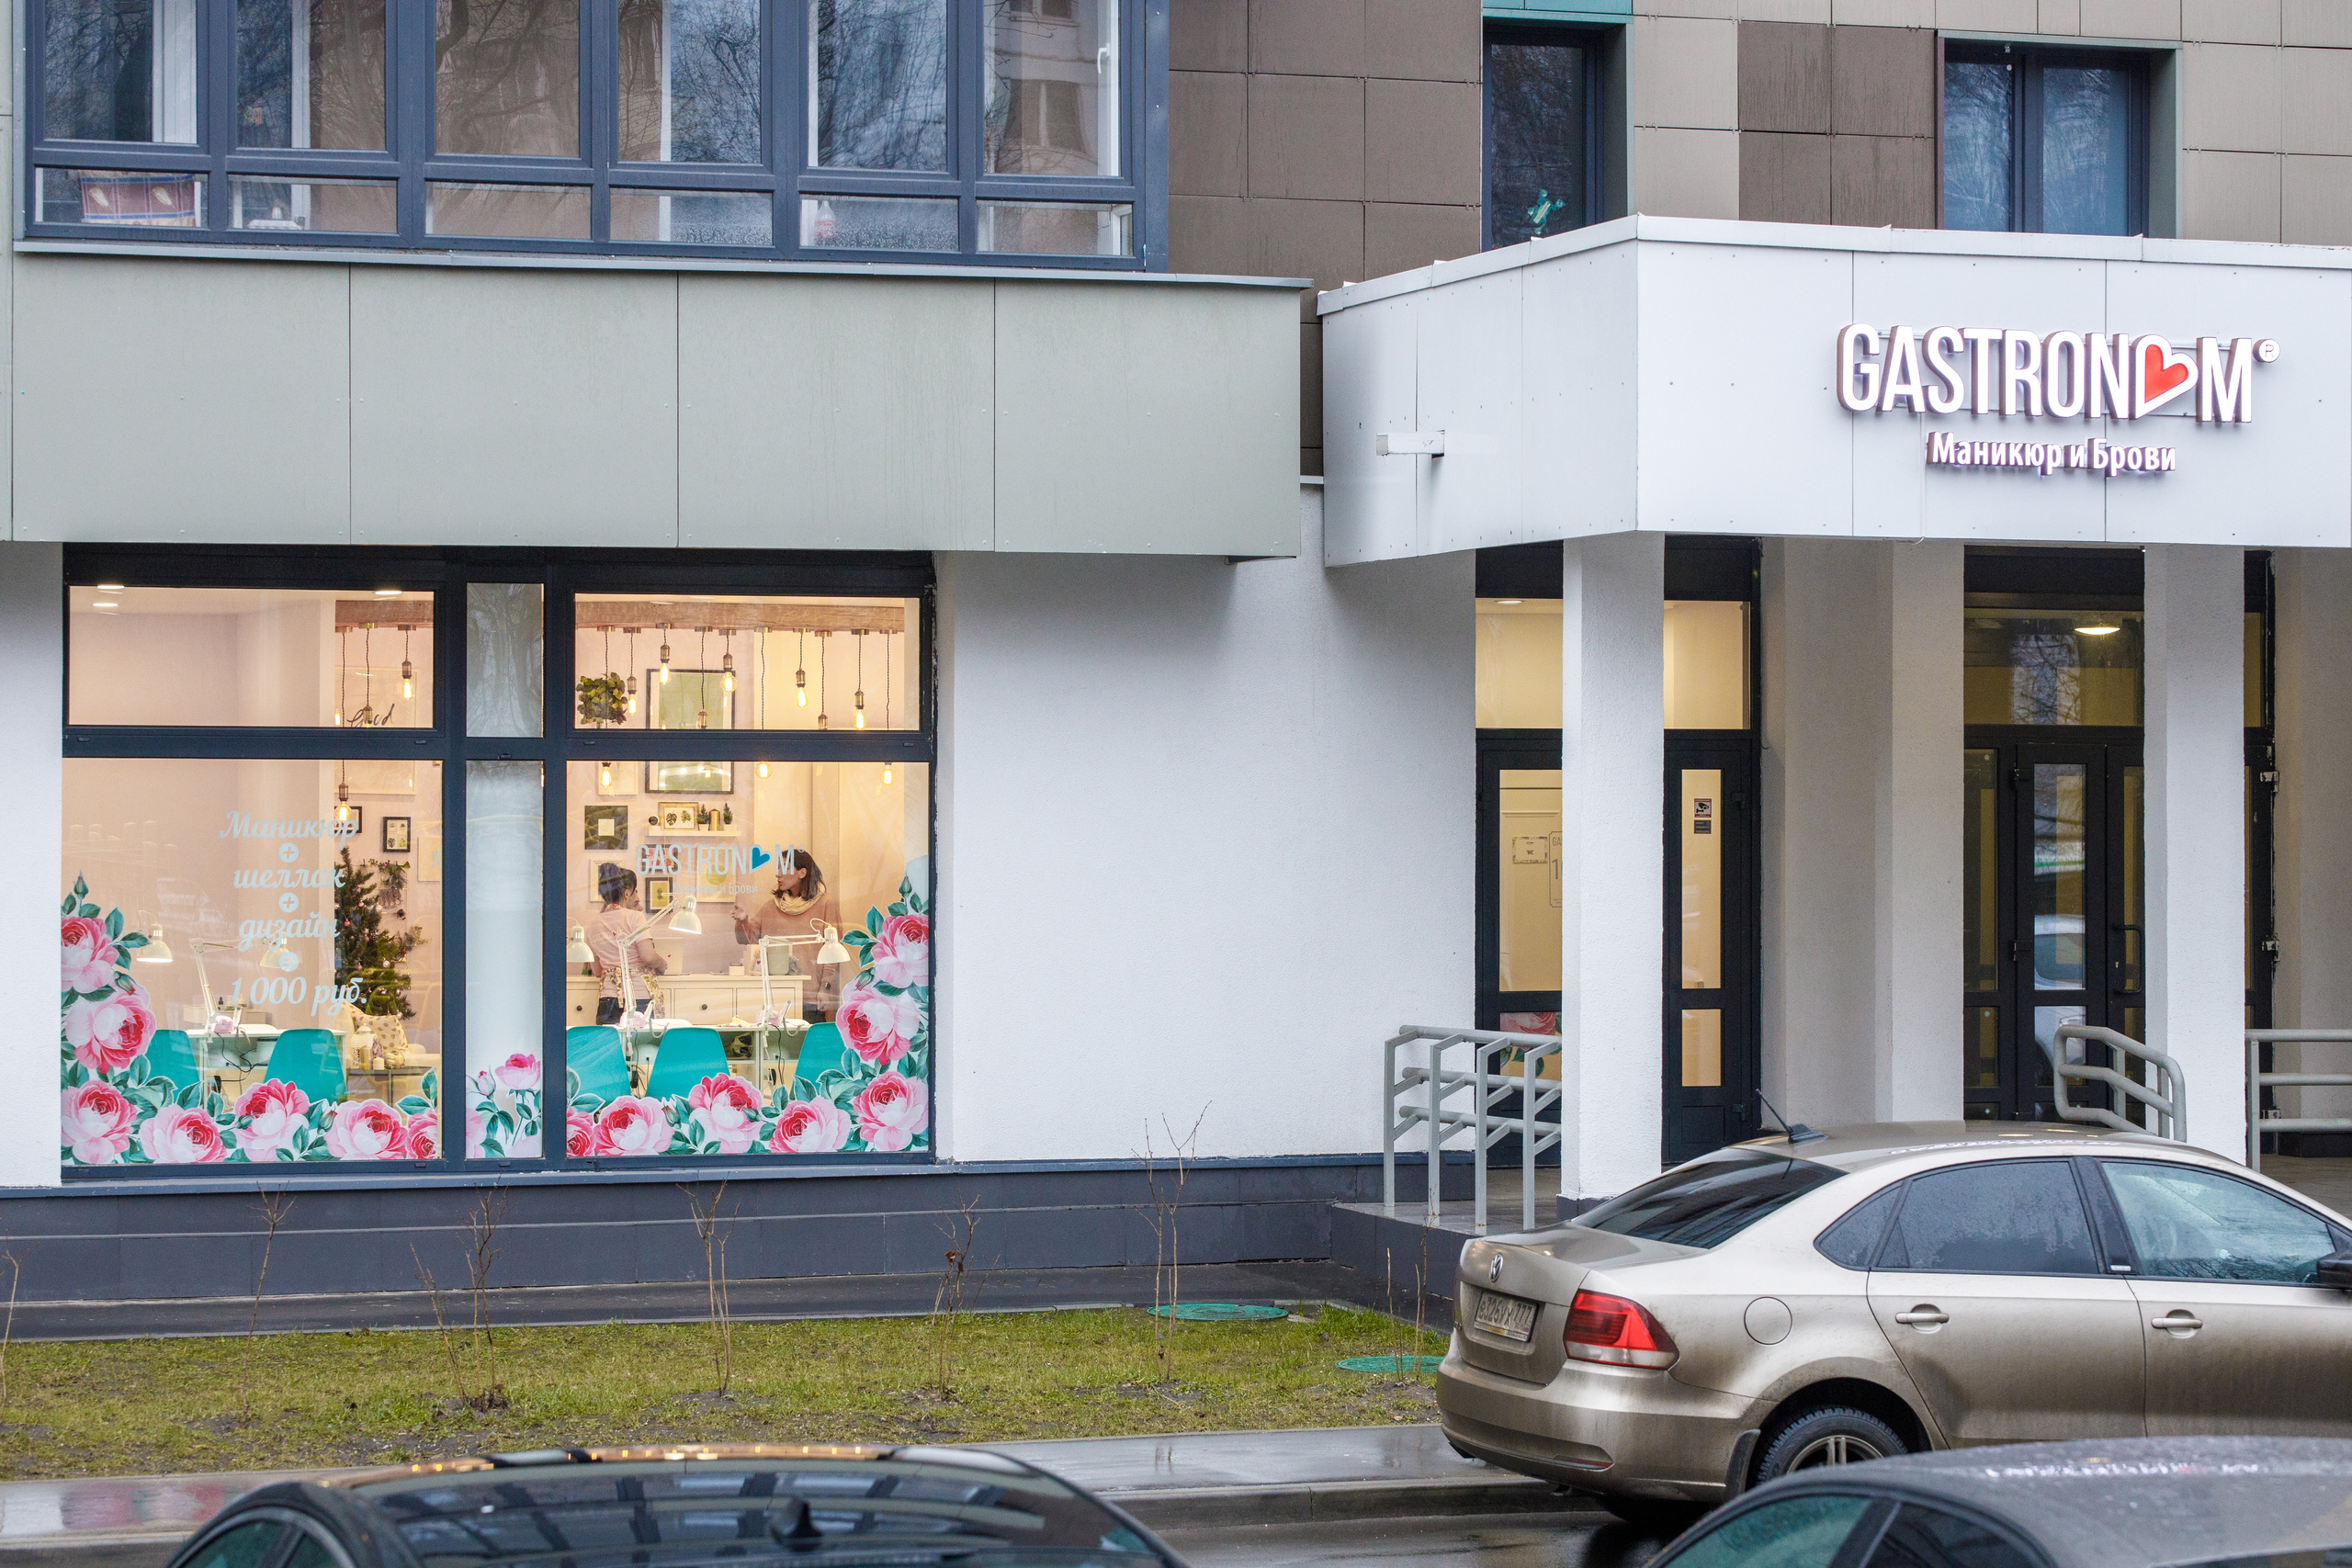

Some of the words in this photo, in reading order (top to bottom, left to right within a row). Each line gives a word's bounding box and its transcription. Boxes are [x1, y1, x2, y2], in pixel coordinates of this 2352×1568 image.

[1927, 431, 2063, 476] Маникюр
[2064, 445, 2085, 468] и
[2087, 437, 2177, 477] Брови
[219, 809, 358, 851] Маникюр
[233, 868, 345, 888] шеллак
[673, 883, 718, 897] Маникюр
[729, 883, 758, 897] Брови
[237, 911, 340, 952] дизайн
[311, 977, 368, 1017] руб.
